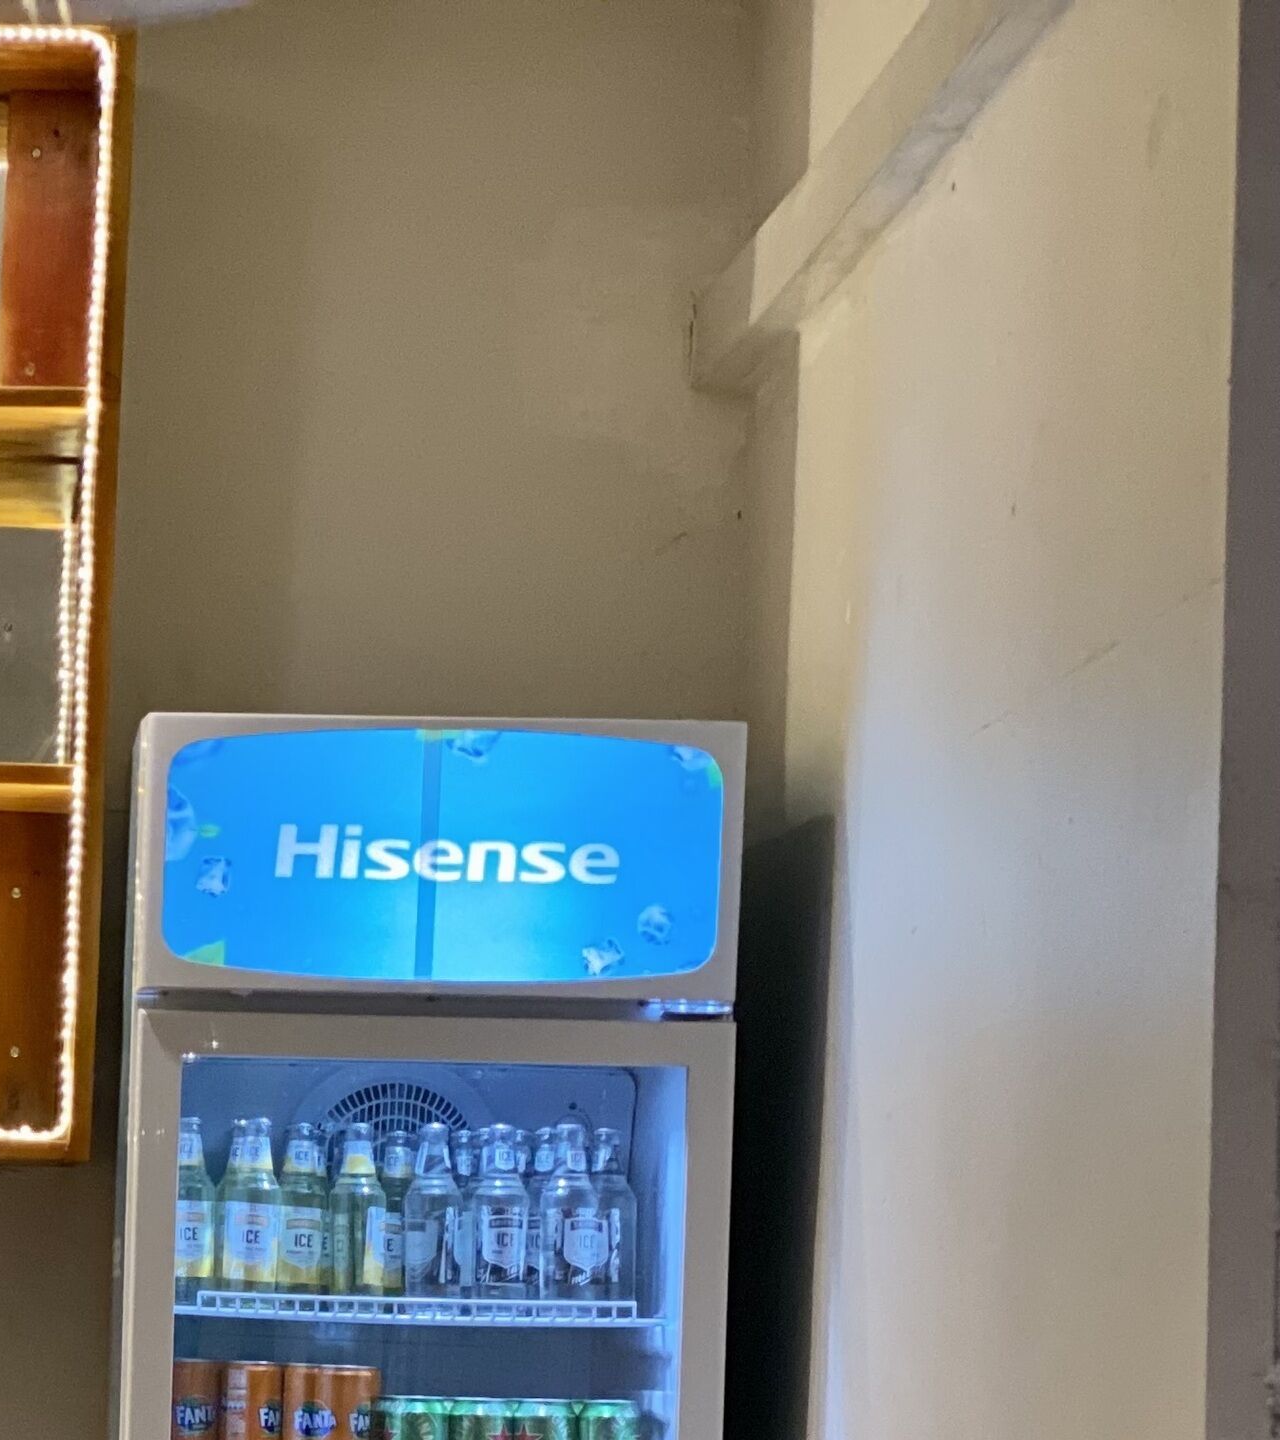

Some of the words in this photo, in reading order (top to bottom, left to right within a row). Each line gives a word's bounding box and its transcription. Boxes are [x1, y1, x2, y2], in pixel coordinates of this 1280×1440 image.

[274, 823, 620, 885] Hisense
[180, 1226, 199, 1241] ICE
[241, 1229, 260, 1244] ICE
[294, 1233, 313, 1248] ICE
[293, 1407, 337, 1430] FANTA
